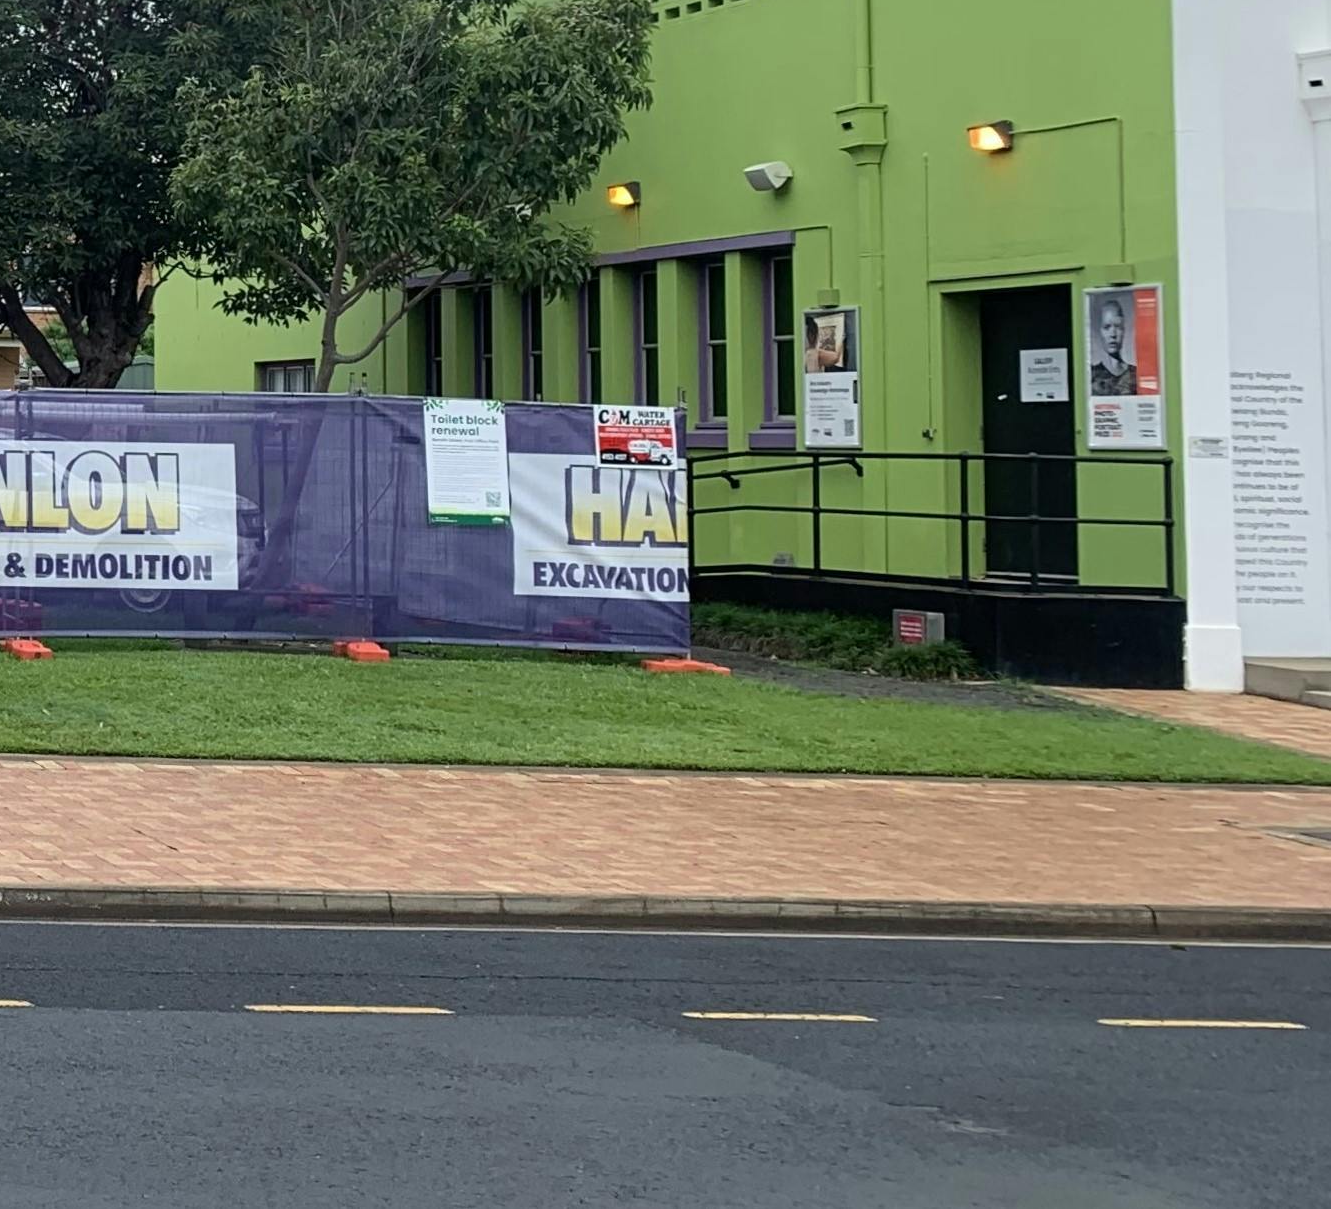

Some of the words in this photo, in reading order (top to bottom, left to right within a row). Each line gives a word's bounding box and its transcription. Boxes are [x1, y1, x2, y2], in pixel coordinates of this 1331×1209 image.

[431, 414, 464, 424] Toilet
[466, 415, 498, 425] block
[637, 411, 665, 419] WATER
[632, 419, 671, 427] CARTAGE
[431, 427, 480, 436] renewal
[565, 465, 688, 548] HA
[5, 553, 27, 578] &
[39, 553, 213, 581] DEMOLITION
